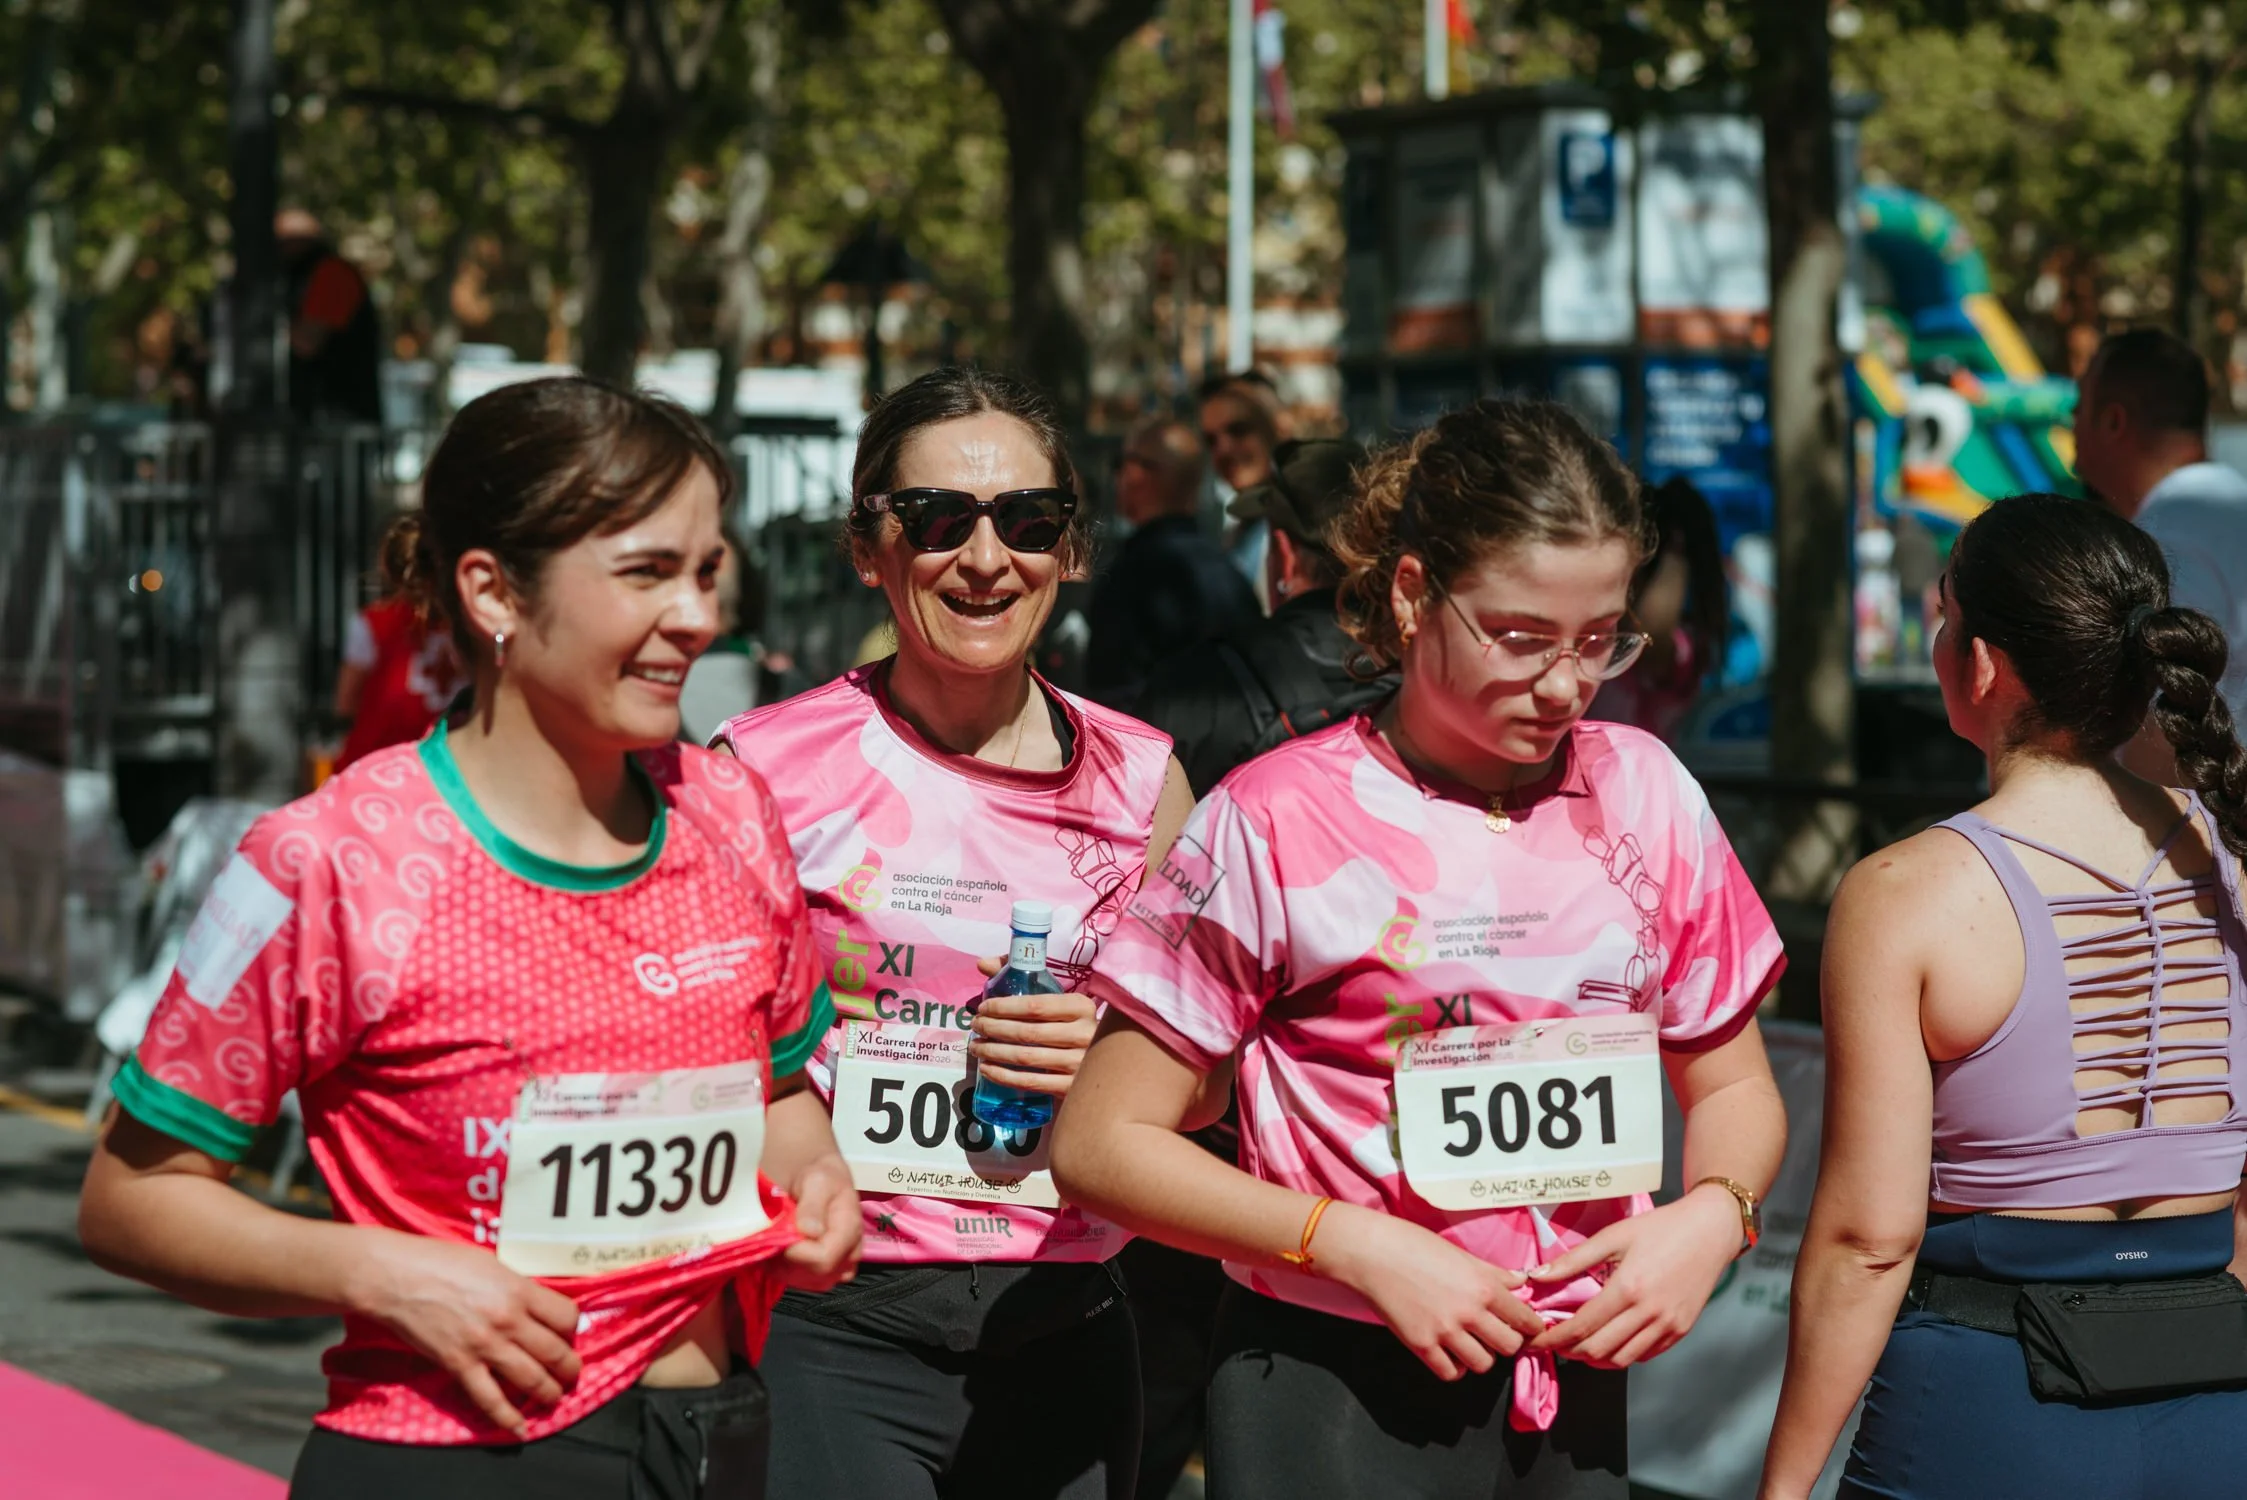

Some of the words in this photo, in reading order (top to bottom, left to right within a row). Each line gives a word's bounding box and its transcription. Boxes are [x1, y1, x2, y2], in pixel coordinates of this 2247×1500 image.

[892, 873, 953, 887] asociación
[956, 879, 1007, 892] española
[891, 886, 929, 898] contra
[931, 889, 941, 899] el
[944, 891, 984, 903] cáncer
[891, 900, 905, 909] en
[908, 900, 921, 911] La
[924, 902, 952, 916] Rioja
[876, 941, 915, 977] XI
[1438, 949, 1453, 958] en
[1456, 946, 1471, 957] La
[1472, 944, 1501, 959] Rioja
[1433, 993, 1472, 1028] XI
[858, 1031, 873, 1044] XI
[875, 1036, 916, 1048] Carrera
[918, 1042, 937, 1051] por
[939, 1042, 950, 1051] la
[1432, 1042, 1475, 1053] Carrera
[1477, 1039, 1496, 1050] por
[1499, 1038, 1511, 1047] la
[856, 1046, 929, 1061] investigación
[1413, 1053, 1490, 1066] investigación
[1441, 1075, 1616, 1157] 5081
[540, 1129, 737, 1218] 11330
[907, 1171, 954, 1187] NATUR
[959, 1176, 1001, 1191] HOUSE
[1544, 1175, 1592, 1190] HOUSE
[2115, 1251, 2148, 1261] OYSHO
